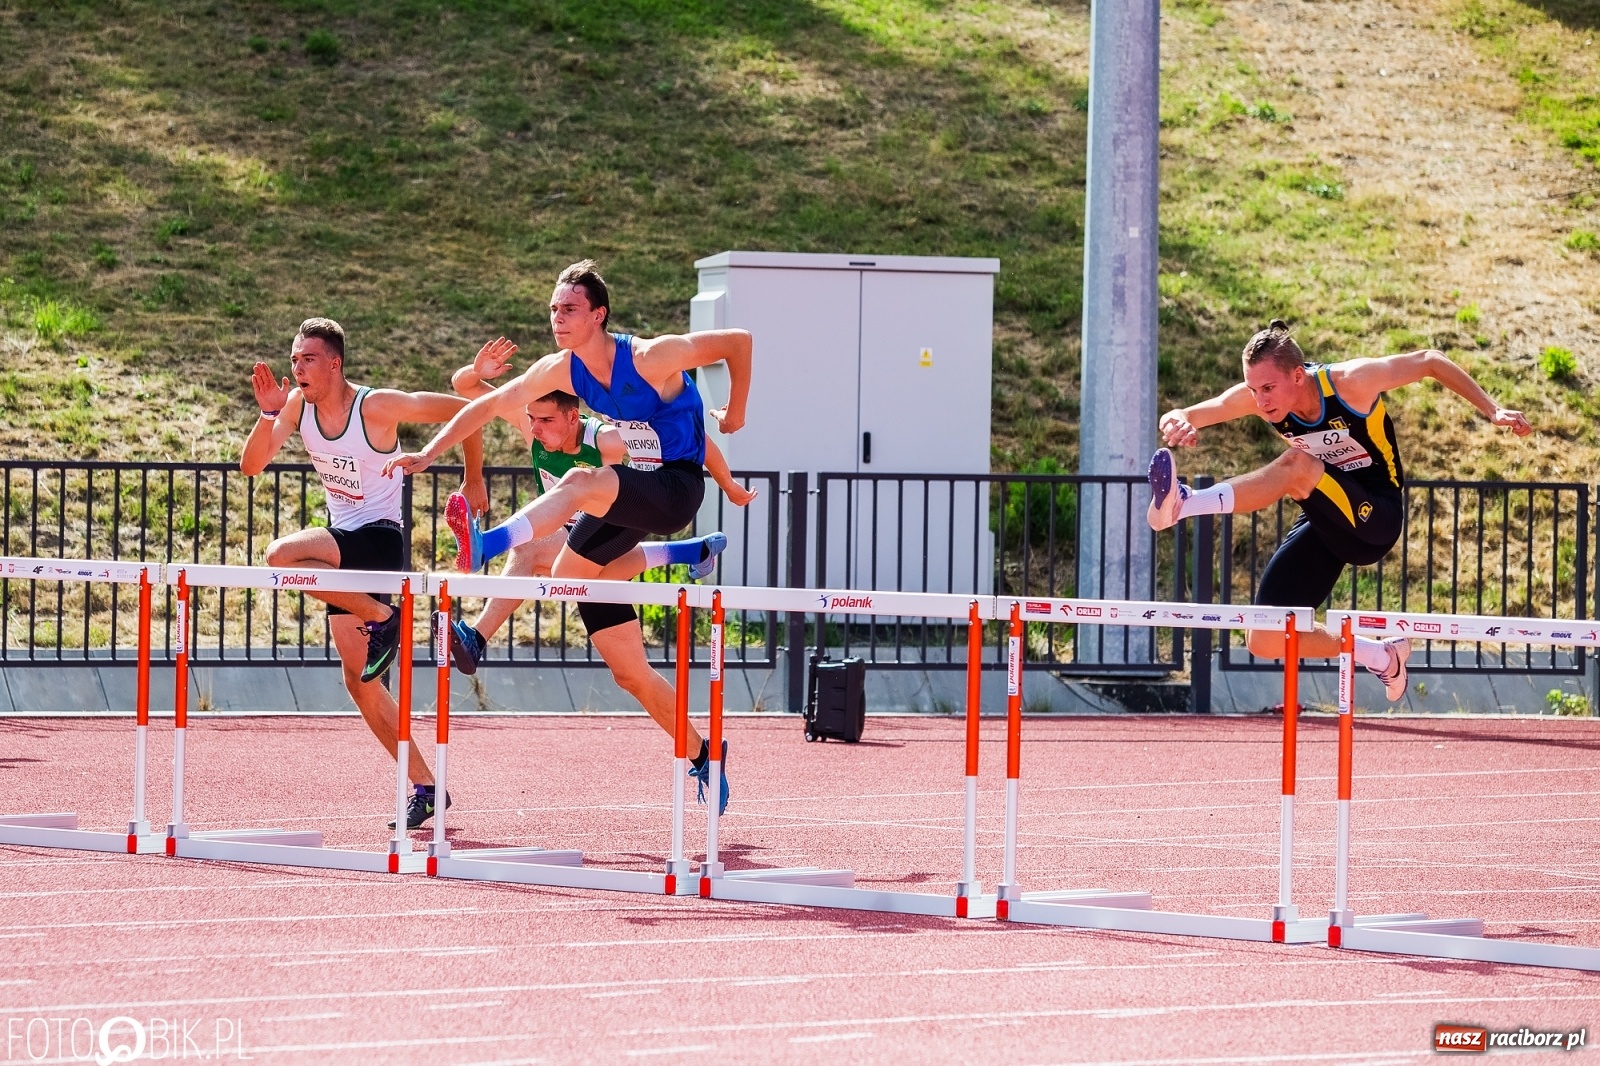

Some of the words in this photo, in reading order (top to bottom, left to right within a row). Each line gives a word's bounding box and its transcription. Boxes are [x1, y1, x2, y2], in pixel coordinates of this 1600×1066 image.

[1322, 432, 1344, 446] 62
[623, 439, 659, 450] NIEWSKI
[332, 457, 357, 472] 571
[1346, 460, 1363, 470] 2019
[32, 565, 44, 575] 4F
[281, 574, 318, 587] polanik
[549, 584, 589, 597] polanik
[831, 595, 873, 610] polanik
[1077, 607, 1101, 616] ORLEN
[1142, 610, 1156, 619] 4F
[1414, 624, 1440, 632] ORLEN
[1485, 626, 1501, 636] 4F
